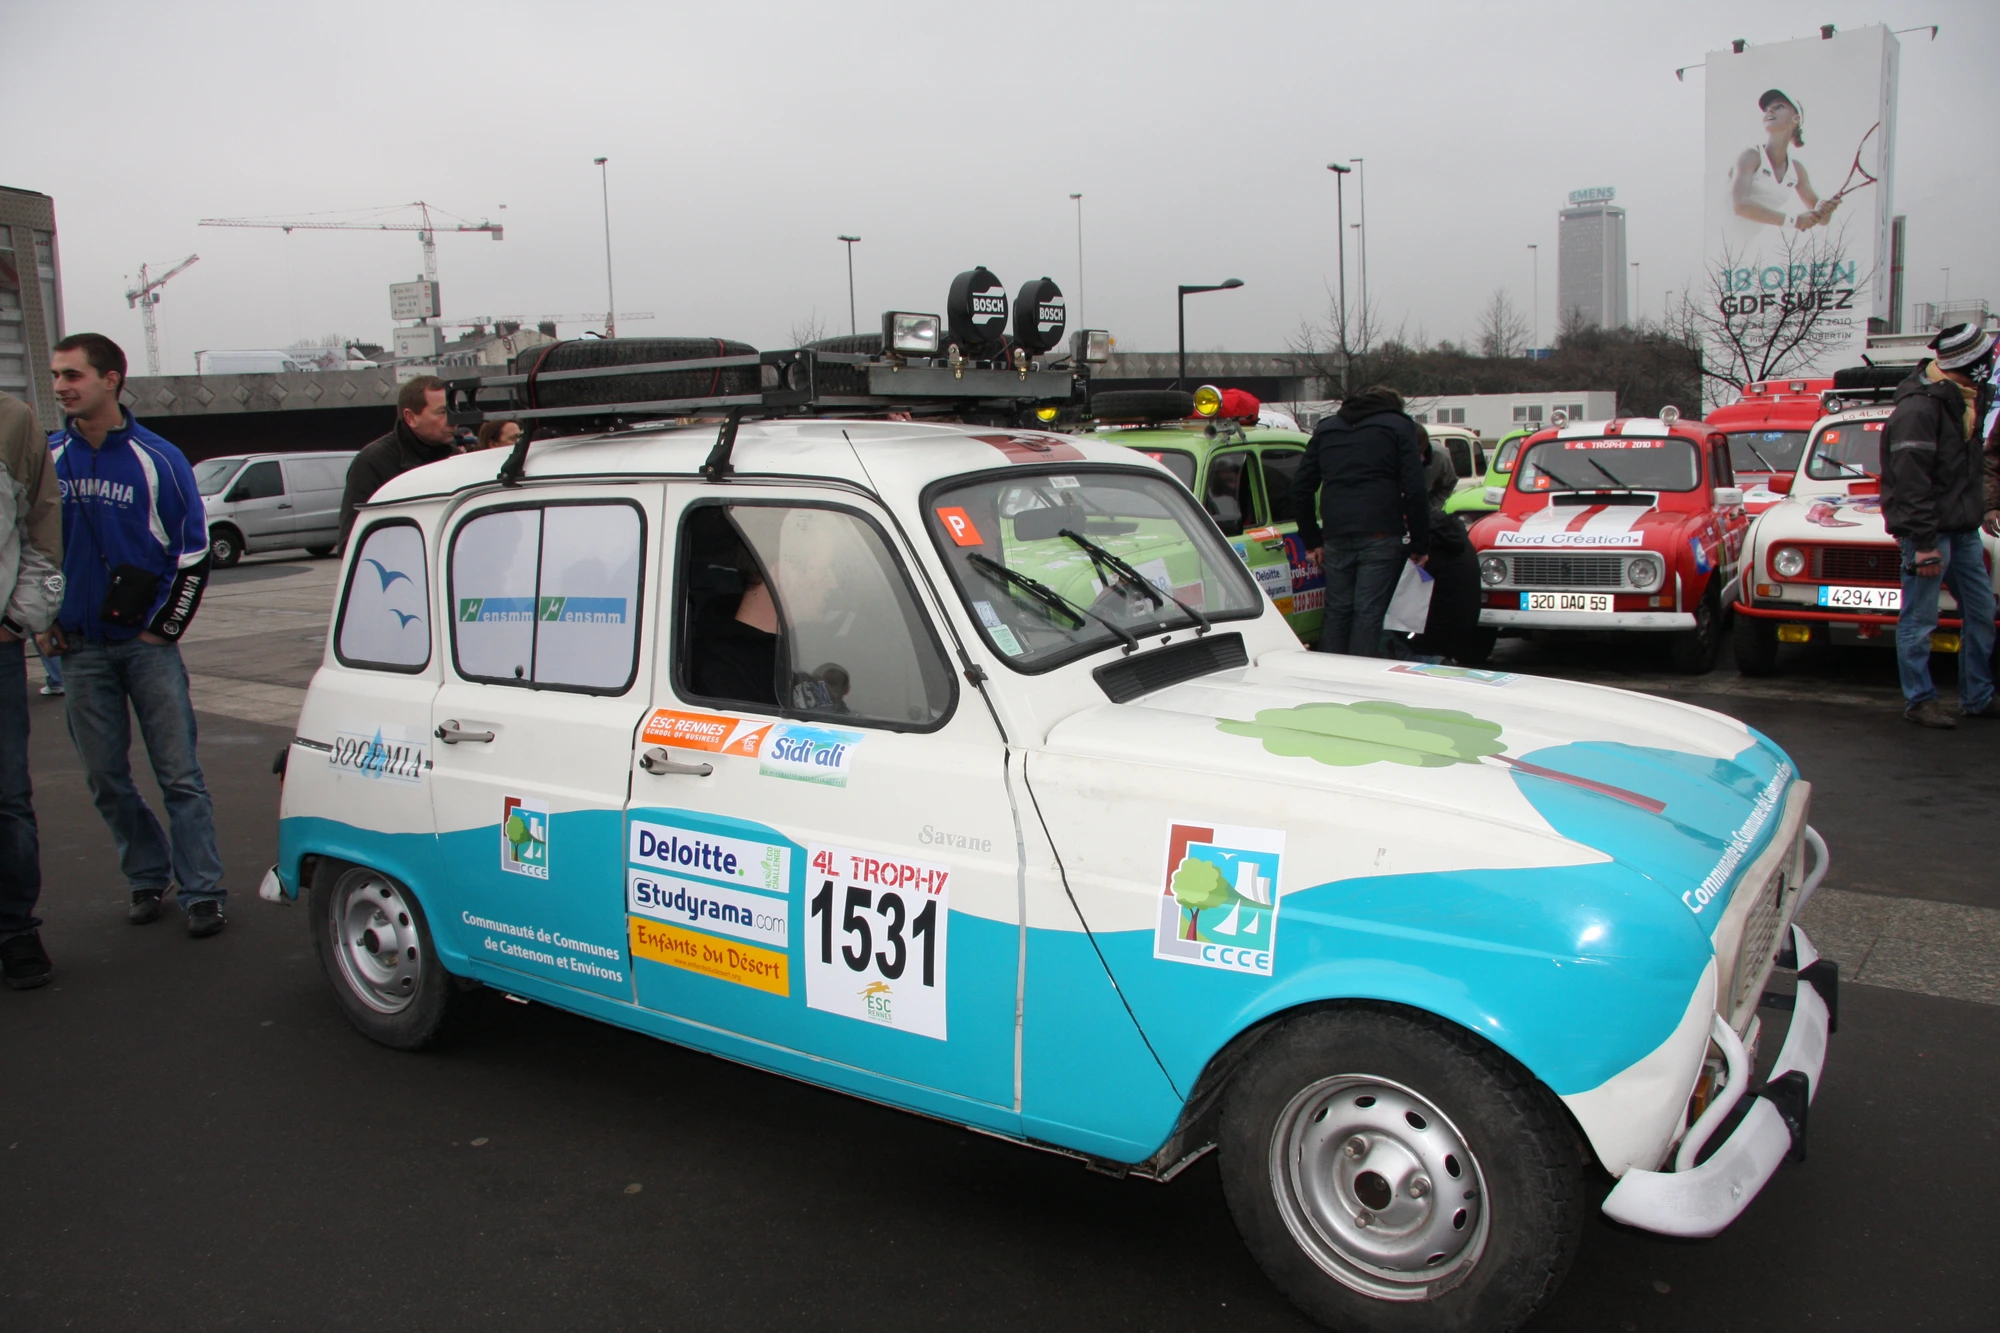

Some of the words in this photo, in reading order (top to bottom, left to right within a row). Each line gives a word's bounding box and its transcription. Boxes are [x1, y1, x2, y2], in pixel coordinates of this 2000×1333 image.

[1760, 260, 1855, 290] OPEN
[973, 298, 1004, 313] BOSCH
[1720, 294, 1776, 316] GDF
[1781, 289, 1853, 313] SUEZ
[1039, 307, 1063, 320] BOSCH
[1801, 331, 1852, 341] OUBERTIN
[1859, 410, 1874, 418] 4L
[1826, 433, 1835, 441] P
[69, 478, 134, 504] YAMAHA
[63, 497, 128, 510] ACING
[947, 515, 965, 537] P
[1500, 533, 1545, 544] Nord
[170, 575, 201, 622] YAMAHA
[1531, 594, 1555, 609] 320
[1560, 595, 1585, 610] DAQ
[1590, 596, 1607, 610] 59
[1832, 589, 1872, 606] 4294
[1878, 591, 1898, 607] YP
[483, 610, 533, 623] ensmm
[565, 611, 621, 624] ensmm
[646, 727, 671, 738] SCHOOL
[673, 731, 684, 739] OF
[685, 733, 720, 744] BUSINESS
[650, 716, 675, 729] ESC
[674, 719, 726, 736] RENNES
[330, 736, 421, 778] SOGEMIA
[771, 737, 814, 764] Sidi
[815, 743, 846, 768] ali
[918, 825, 992, 852] Savane
[766, 846, 774, 862] ECO
[520, 864, 548, 878] CCCE
[773, 847, 781, 890] CHALLENGE
[812, 850, 840, 877] 4L
[849, 855, 949, 896] TROPHY
[1682, 839, 1742, 914] Communauté
[764, 879, 772, 889] 4L
[462, 910, 535, 939] Communauté
[536, 928, 551, 943] de
[553, 932, 620, 960] Communes
[811, 879, 937, 988] 1531
[484, 936, 498, 951] de
[499, 940, 555, 966] Cattenom
[556, 955, 568, 969] et
[570, 957, 623, 983] Environs
[637, 924, 698, 958] Enfants
[703, 944, 723, 964] du
[727, 948, 780, 980] Désert
[1202, 945, 1269, 970] CCCE
[867, 995, 892, 1013] ESC
[867, 1008, 892, 1021] RENNES
